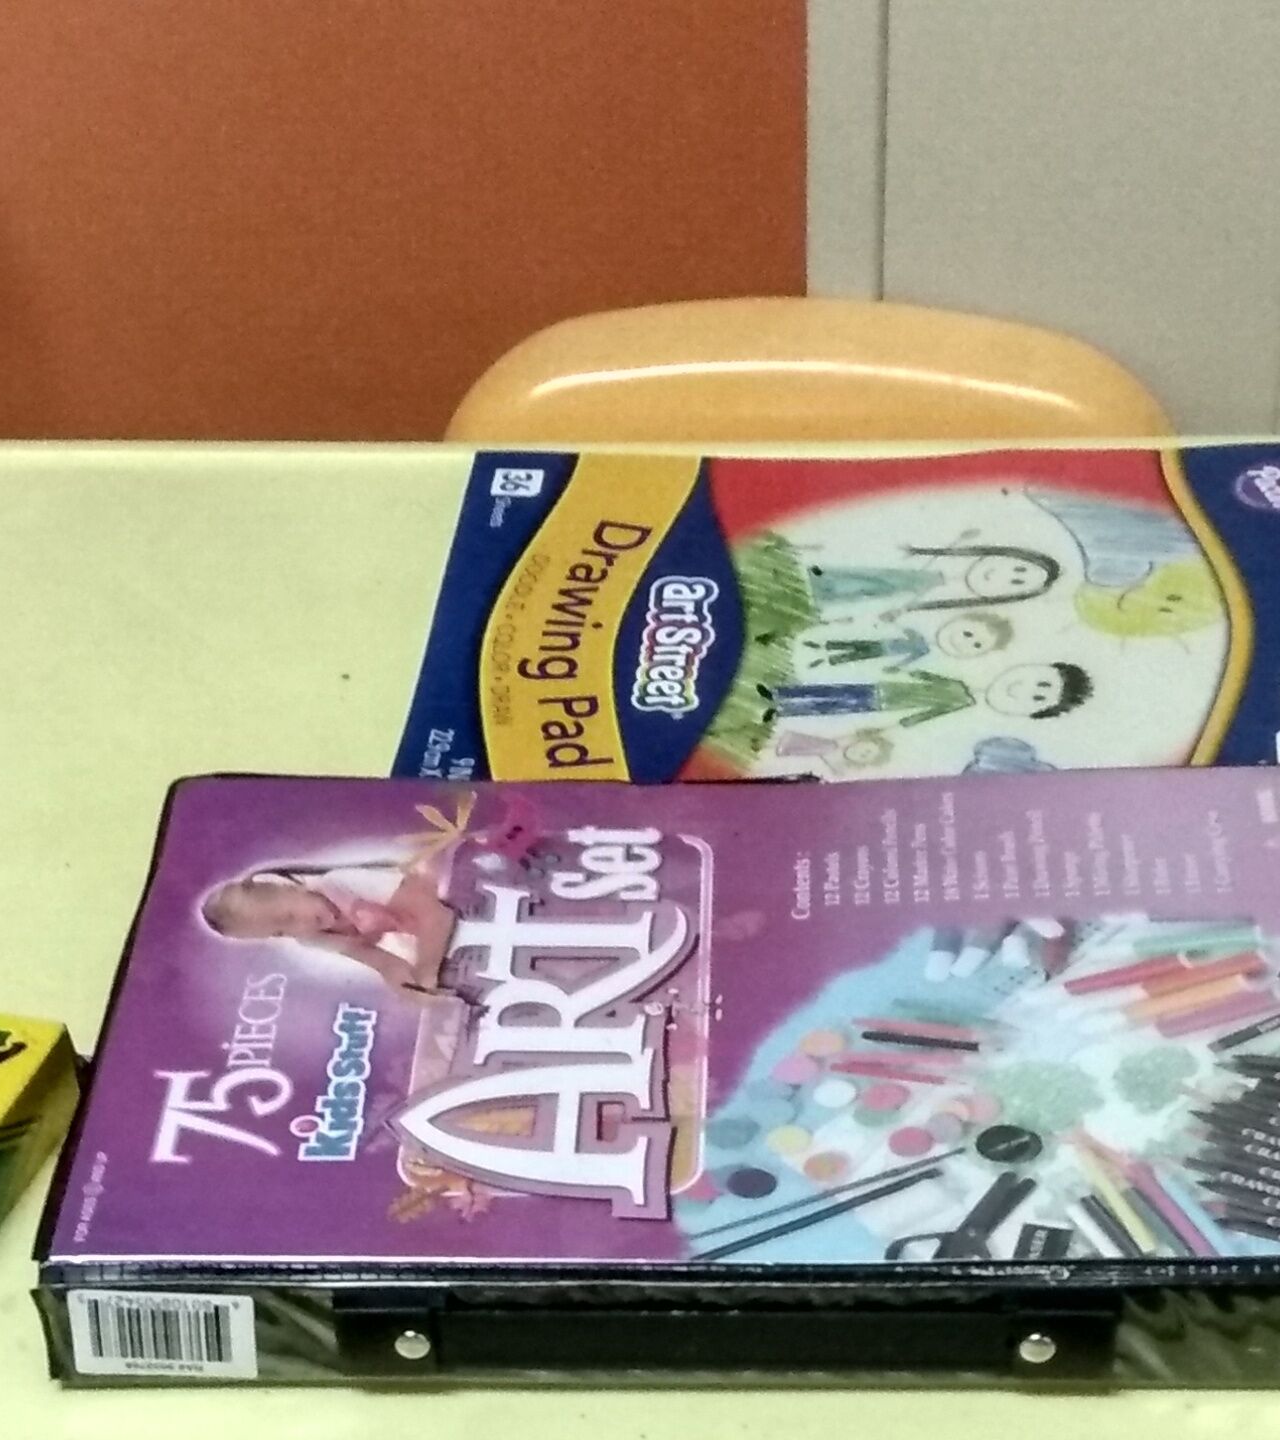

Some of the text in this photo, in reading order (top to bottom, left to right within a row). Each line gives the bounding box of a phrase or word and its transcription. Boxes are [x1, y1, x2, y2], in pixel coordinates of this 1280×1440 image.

[498, 471, 535, 492] 36
[490, 622, 518, 673] COLOR
[517, 519, 653, 769] Drawing Pad
[550, 826, 663, 900] Set
[397, 884, 689, 1206] ART
[151, 1067, 293, 1164] 75
